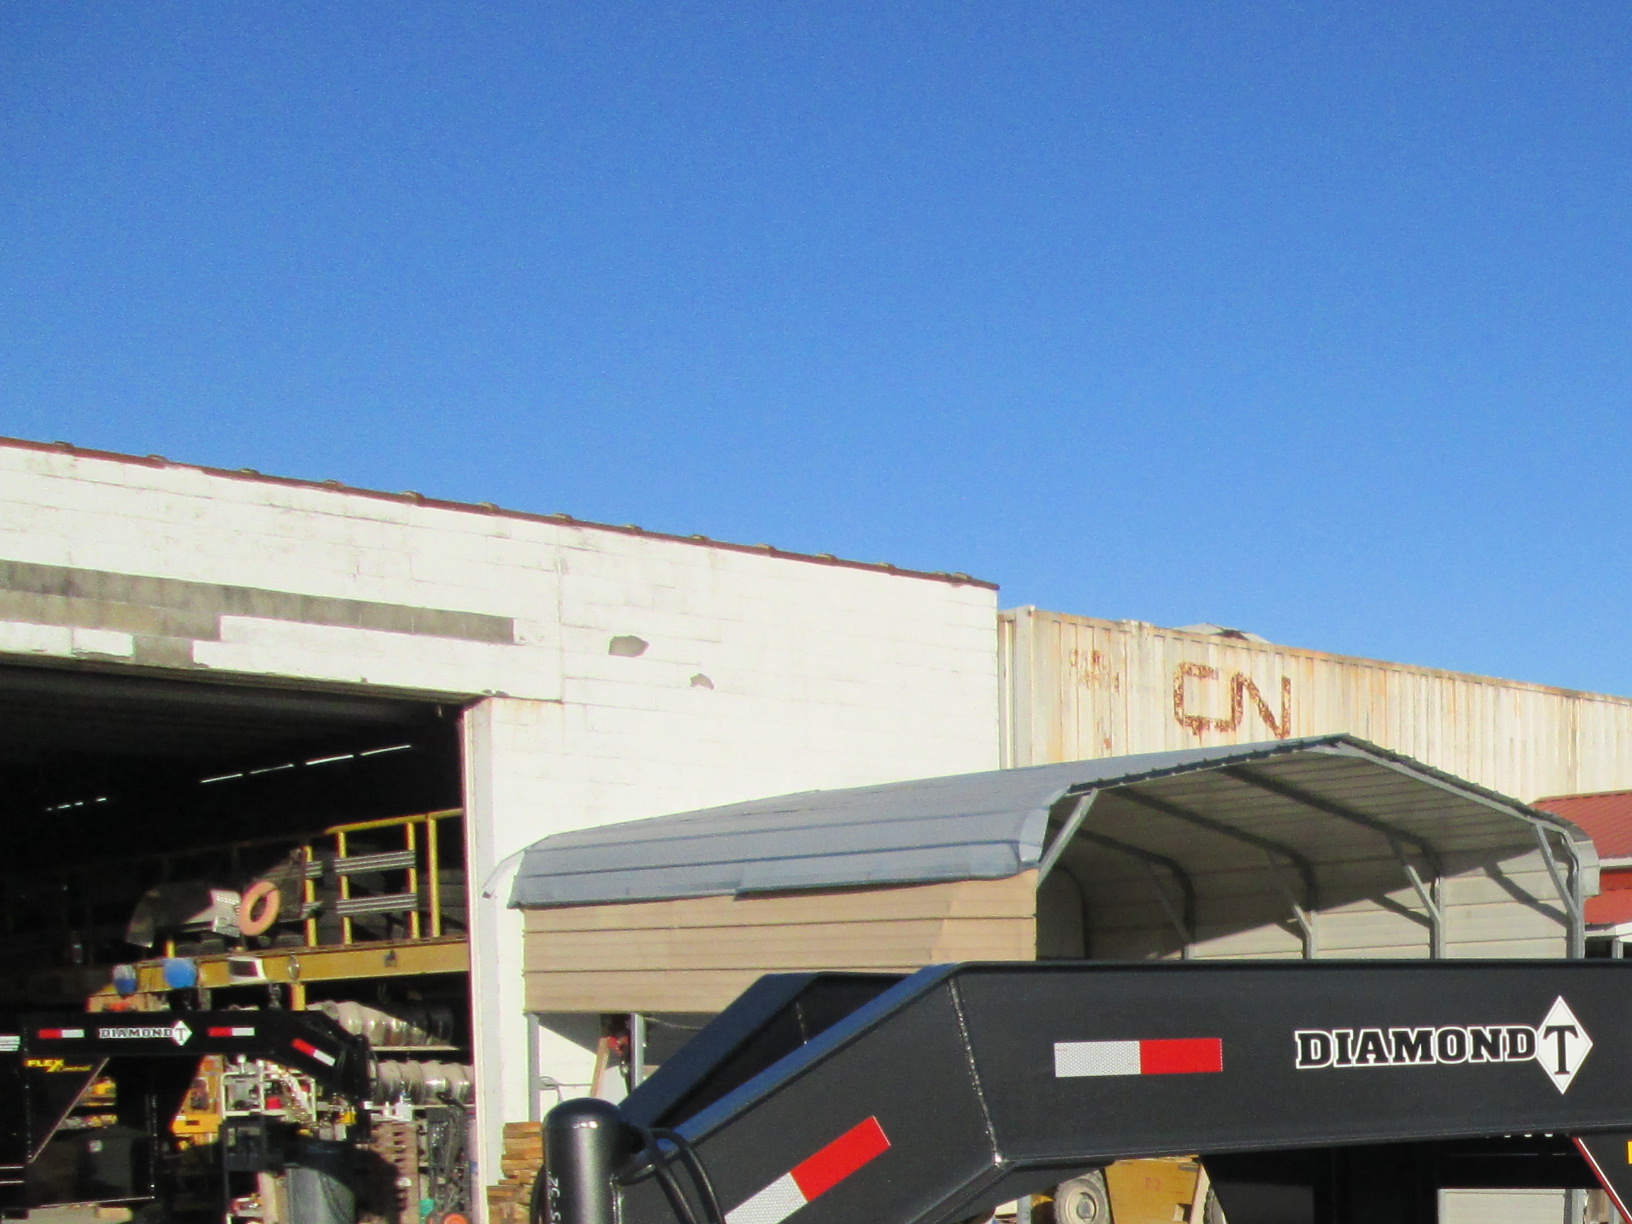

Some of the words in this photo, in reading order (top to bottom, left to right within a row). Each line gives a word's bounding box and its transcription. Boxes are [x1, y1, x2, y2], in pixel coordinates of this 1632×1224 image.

[1174, 662, 1291, 739] CN
[98, 1027, 173, 1039] DIAMOND
[27, 1058, 65, 1073] FLEX
[1295, 1025, 1538, 1069] DIAMOND
[1543, 1025, 1580, 1076] T
